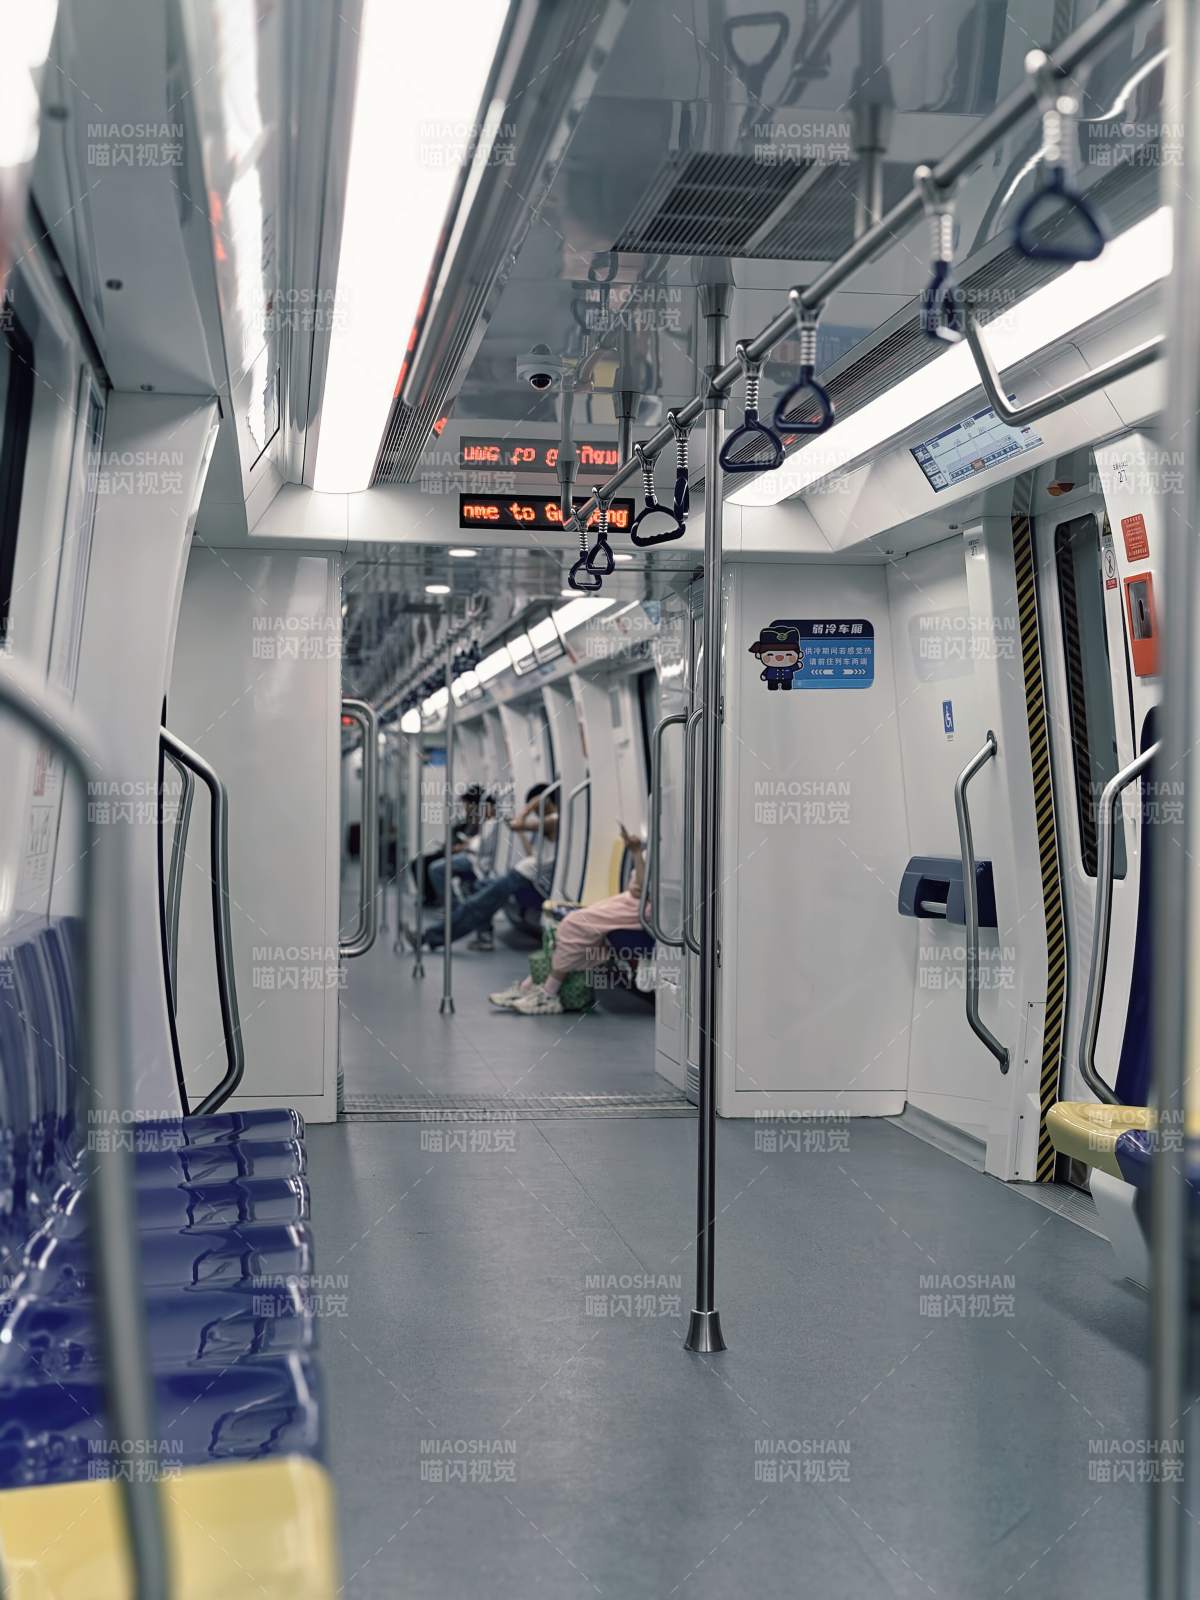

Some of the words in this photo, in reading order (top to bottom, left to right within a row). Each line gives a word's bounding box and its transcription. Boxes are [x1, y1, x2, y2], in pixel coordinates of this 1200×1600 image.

[510, 502, 536, 521] to
[812, 624, 863, 634] 弱冷车厢
